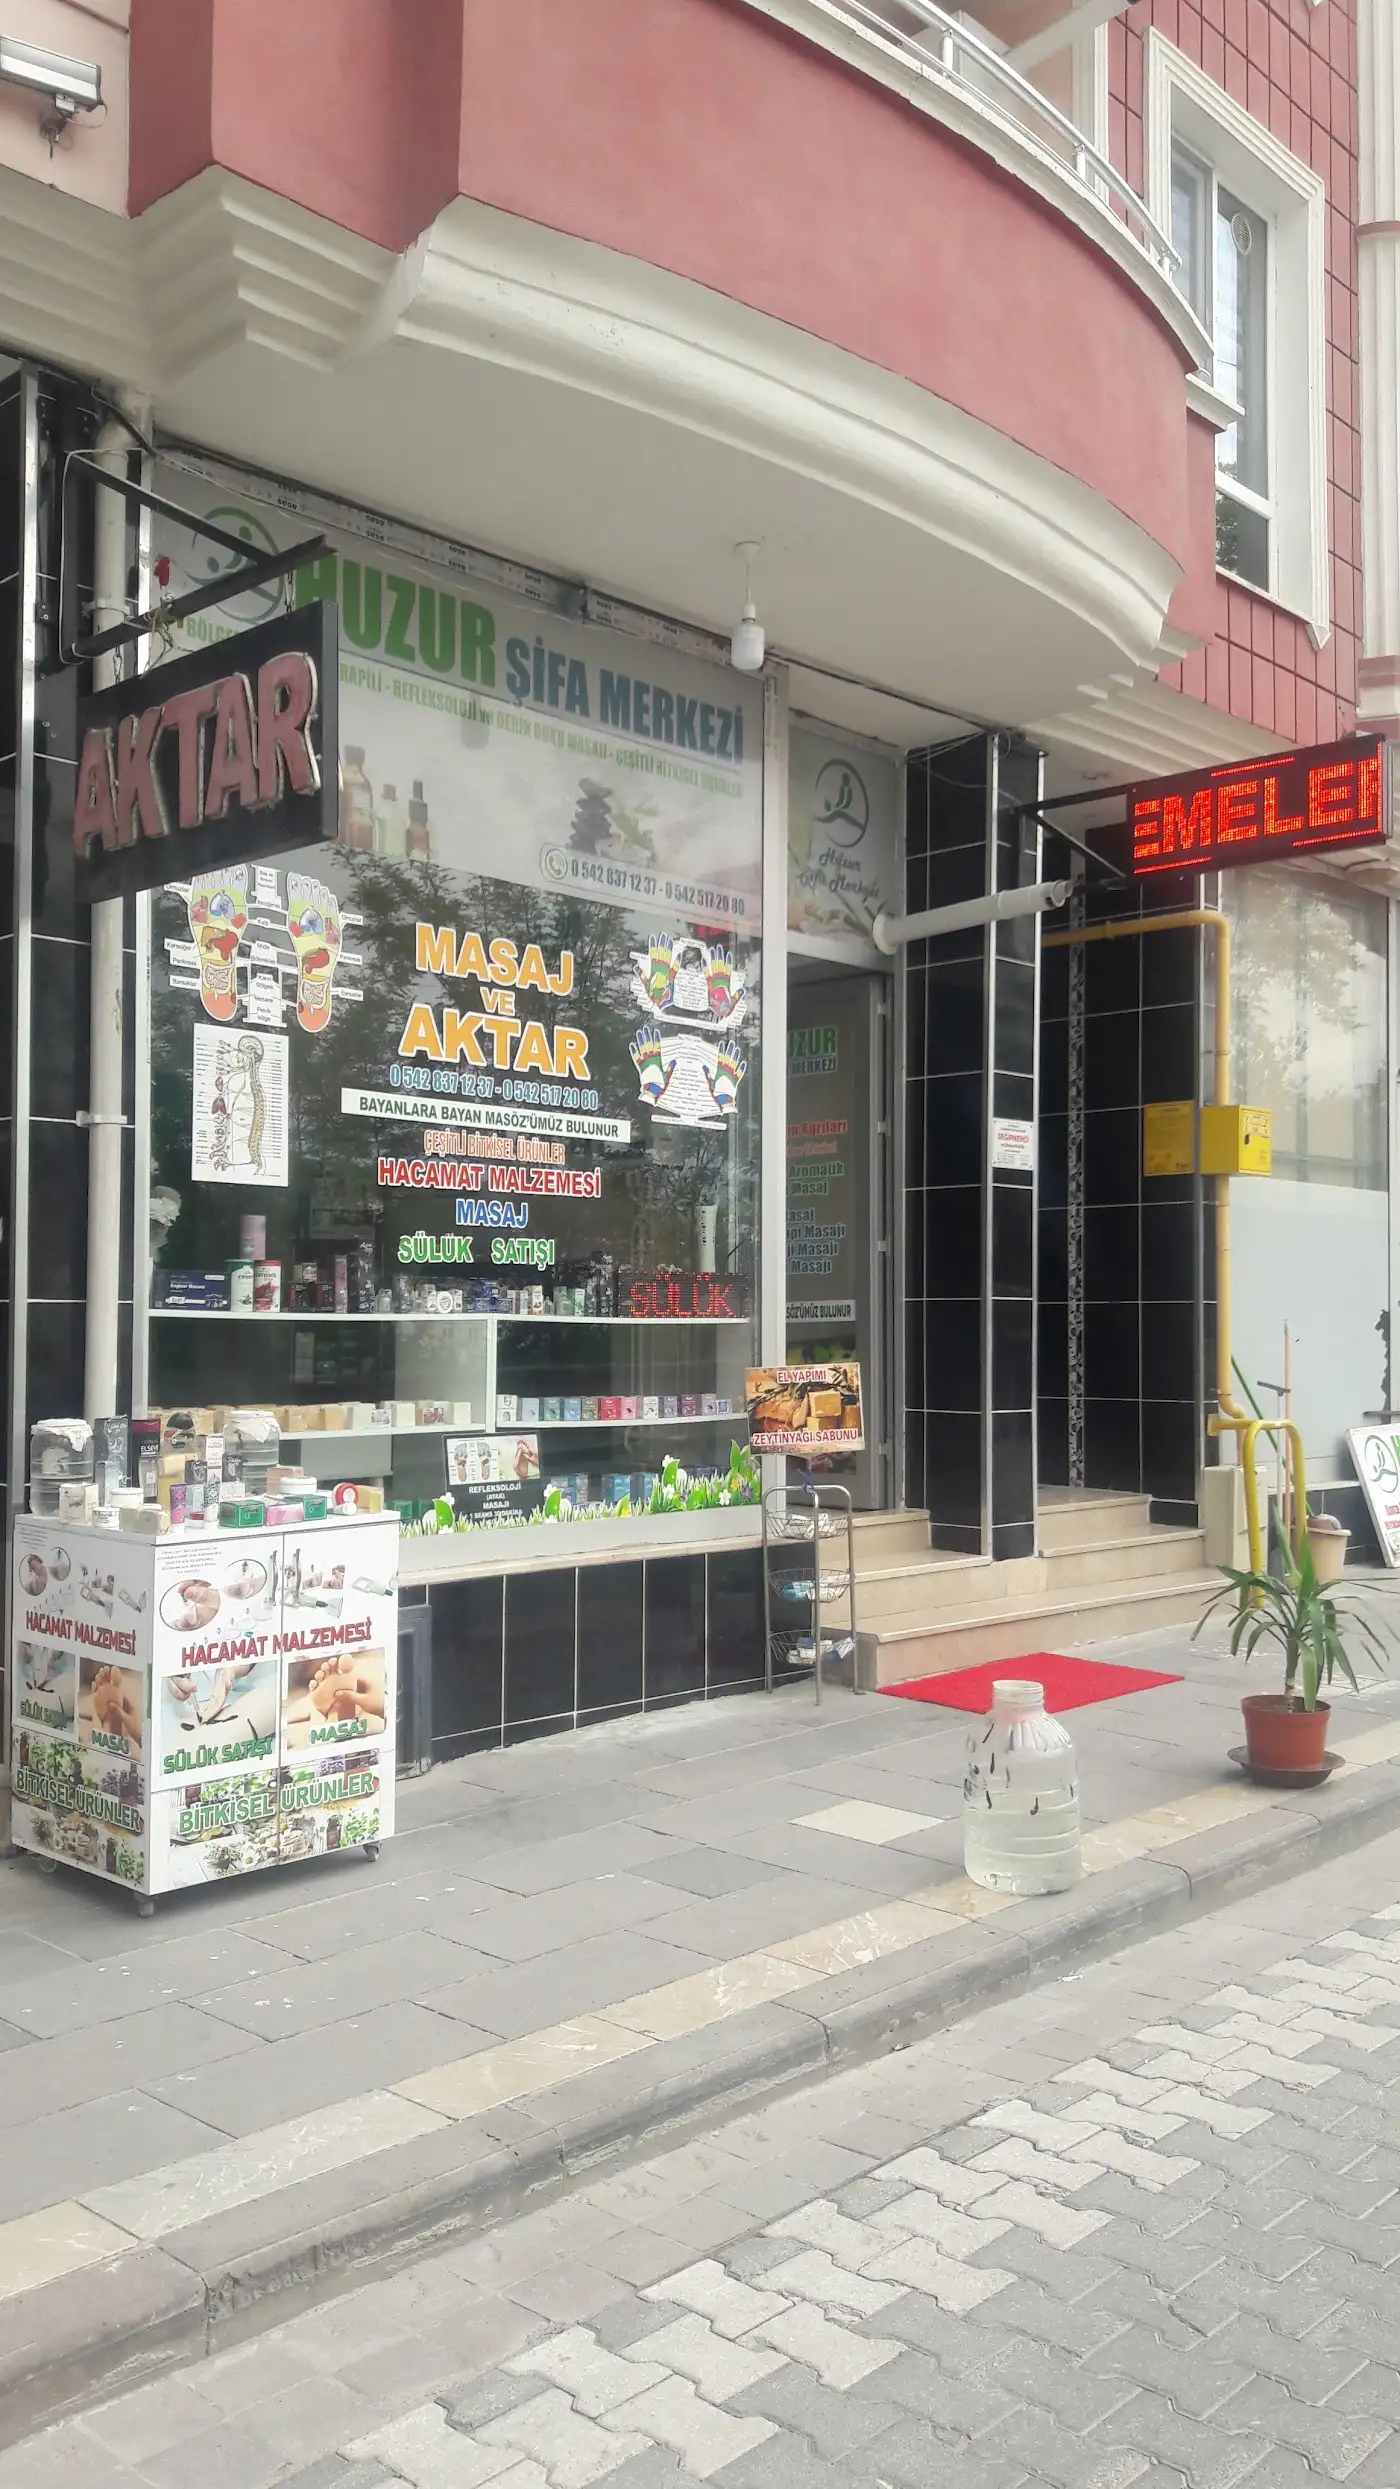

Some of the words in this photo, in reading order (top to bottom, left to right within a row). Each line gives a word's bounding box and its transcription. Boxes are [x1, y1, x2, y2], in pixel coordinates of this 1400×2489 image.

[296, 550, 496, 689] HUZUR
[505, 635, 590, 719] ŞİFA
[599, 668, 744, 764] MERKEZİ
[73, 651, 322, 860] AKTAR
[581, 862, 604, 884] 542
[606, 868, 627, 889] 837
[643, 876, 656, 896] 37
[674, 883, 696, 905] 542
[415, 922, 574, 997] MASAJ
[480, 987, 516, 1015] VE
[398, 1003, 591, 1081] AKTAR
[389, 1064, 400, 1087] 0
[402, 1068, 431, 1090] 542
[433, 1071, 458, 1094] 837
[460, 1076, 476, 1096] 12
[476, 1078, 494, 1099] 37
[514, 1082, 539, 1105] 542
[540, 1085, 562, 1107] 517
[562, 1089, 579, 1109] 20
[580, 1090, 599, 1111] 80
[358, 1096, 438, 1120] BAYANLARA
[440, 1108, 482, 1125] BAYAN
[485, 1112, 563, 1133] MASÖZ'ÜMÜZ
[566, 1122, 619, 1138] BULUNUR
[424, 1129, 466, 1158] ÇEŞİTLİ
[467, 1132, 516, 1161] BİTKİSEL
[517, 1136, 566, 1165] ÜRÜNLER
[378, 1157, 484, 1189] HACAMAT
[488, 1165, 602, 1199] MALZEMESİ
[456, 1198, 529, 1228] MASAJ
[785, 1208, 815, 1222] asaj
[398, 1231, 474, 1264] SÜLÜK
[491, 1237, 556, 1271] SATIŞI
[628, 1272, 734, 1320] SÜLÜK
[777, 1370, 789, 1383] EL
[791, 1369, 826, 1382] YAPIMI
[815, 1429, 858, 1443] SABUNU
[469, 1482, 522, 1494] REFLEKSOLOJİ
[26, 1610, 73, 1640] HACAMAT
[75, 1620, 136, 1656] MALZEMESİ
[181, 1635, 268, 1667] HACAMAT
[272, 1617, 372, 1654] MALZEMESİ
[91, 1730, 130, 1755] MASAJ
[310, 1717, 368, 1745] MASAJ
[163, 1746, 219, 1774] SÜLÜK
[16, 1767, 73, 1809] BİTKİSEL
[75, 1785, 141, 1833] ÜRÜNLER
[178, 1793, 275, 1835] BİTKİSEL
[281, 1771, 375, 1811] ÜRÜNLER
